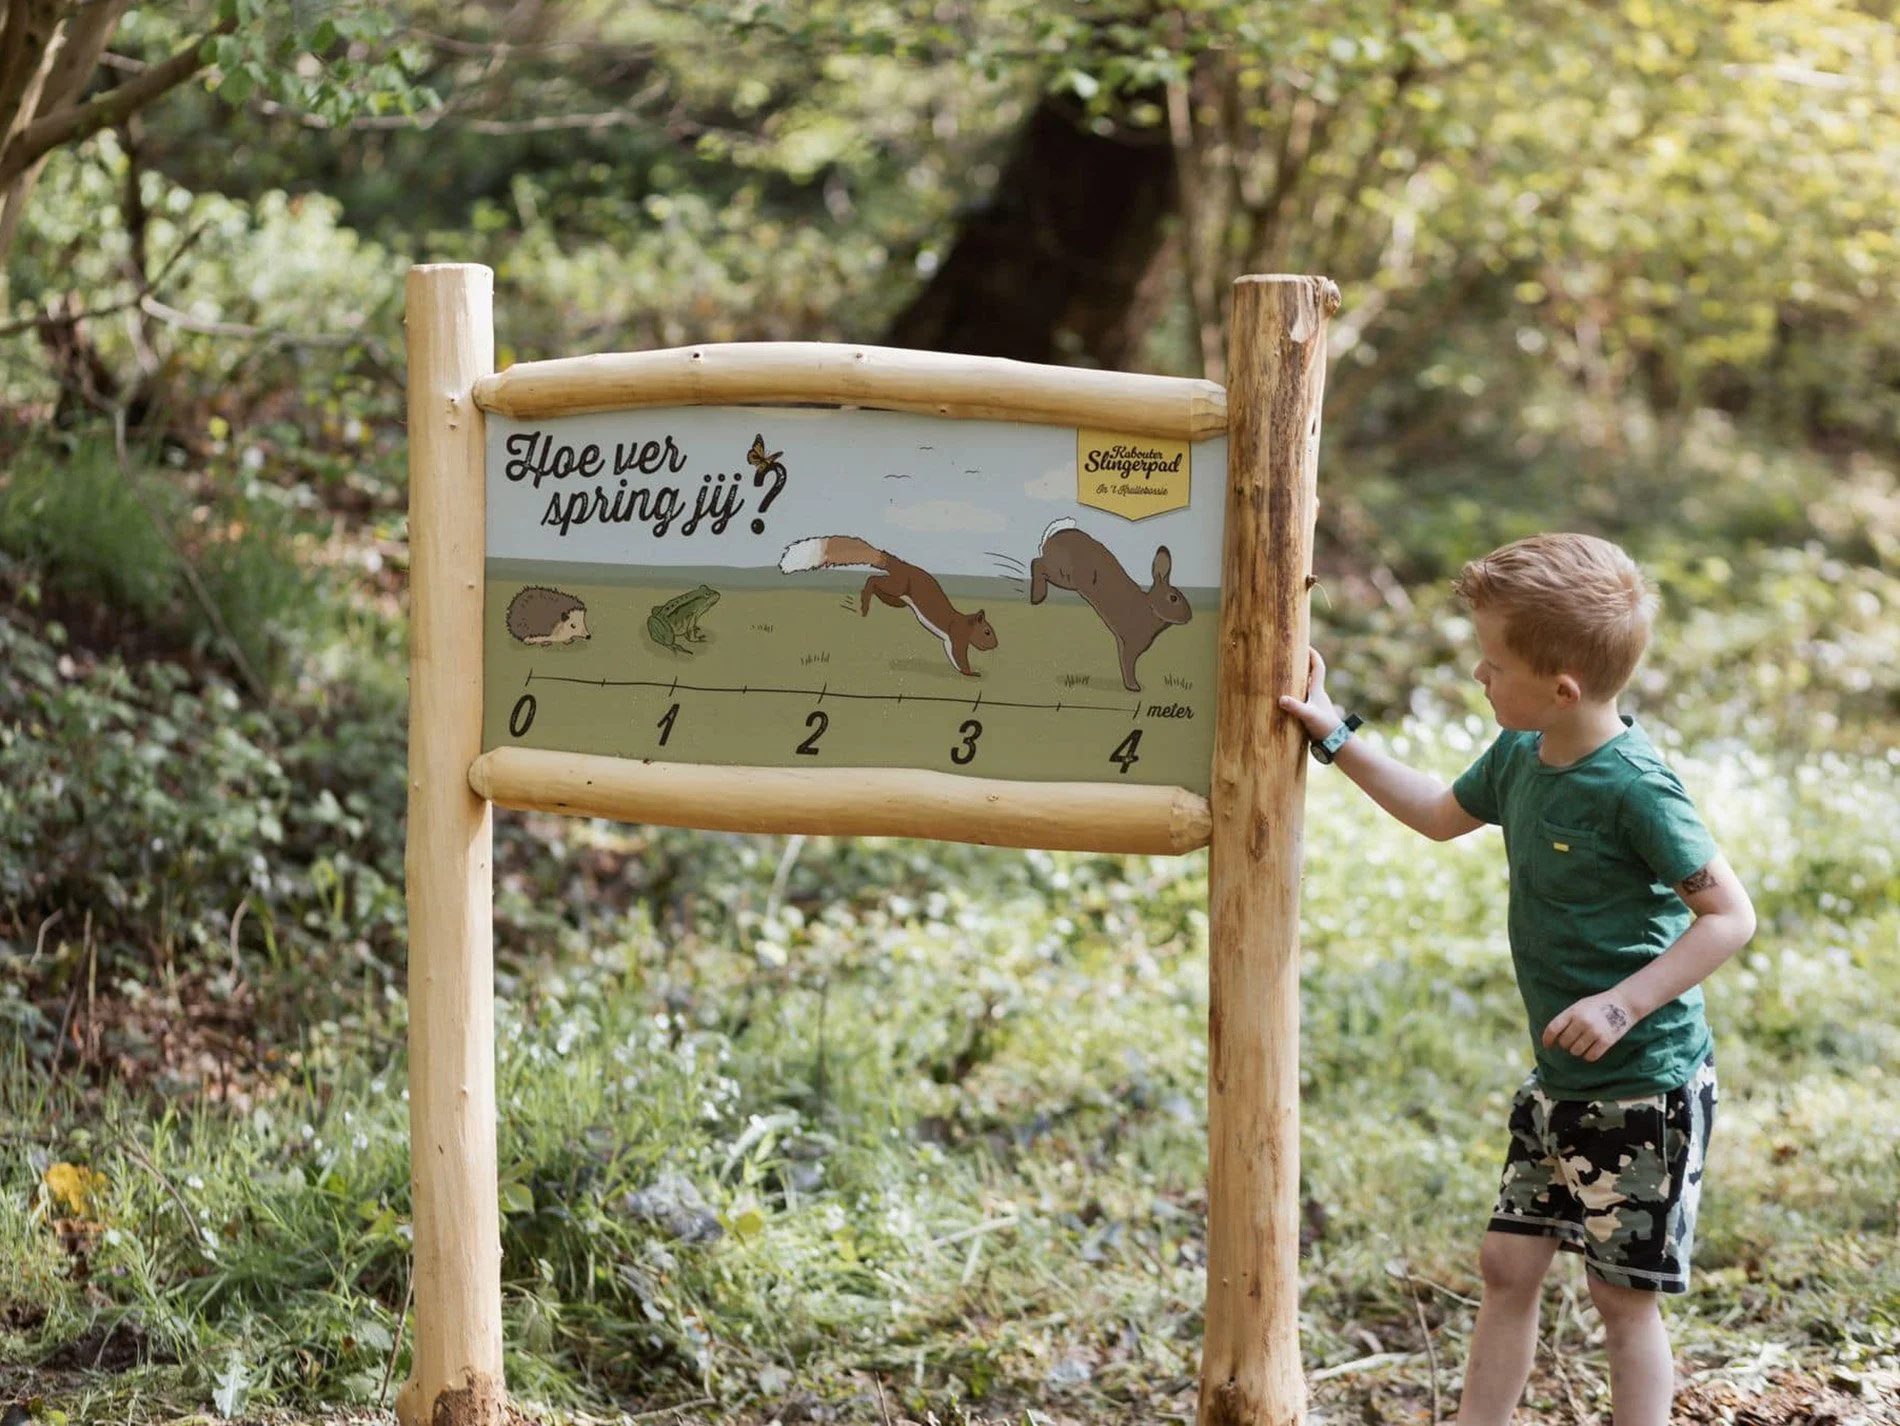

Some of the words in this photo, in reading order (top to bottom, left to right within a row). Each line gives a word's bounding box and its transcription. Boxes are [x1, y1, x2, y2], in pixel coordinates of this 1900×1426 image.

[505, 431, 605, 488] Hoe
[613, 435, 687, 476] ver
[1084, 450, 1183, 479] Slingerpad
[1110, 445, 1163, 460] Kabouter
[541, 479, 686, 538] spring
[1147, 702, 1194, 719] meter
[509, 694, 536, 737] 0
[657, 704, 680, 746] 1
[796, 711, 828, 755] 2
[951, 720, 982, 764] 3
[1109, 729, 1143, 773] 4
